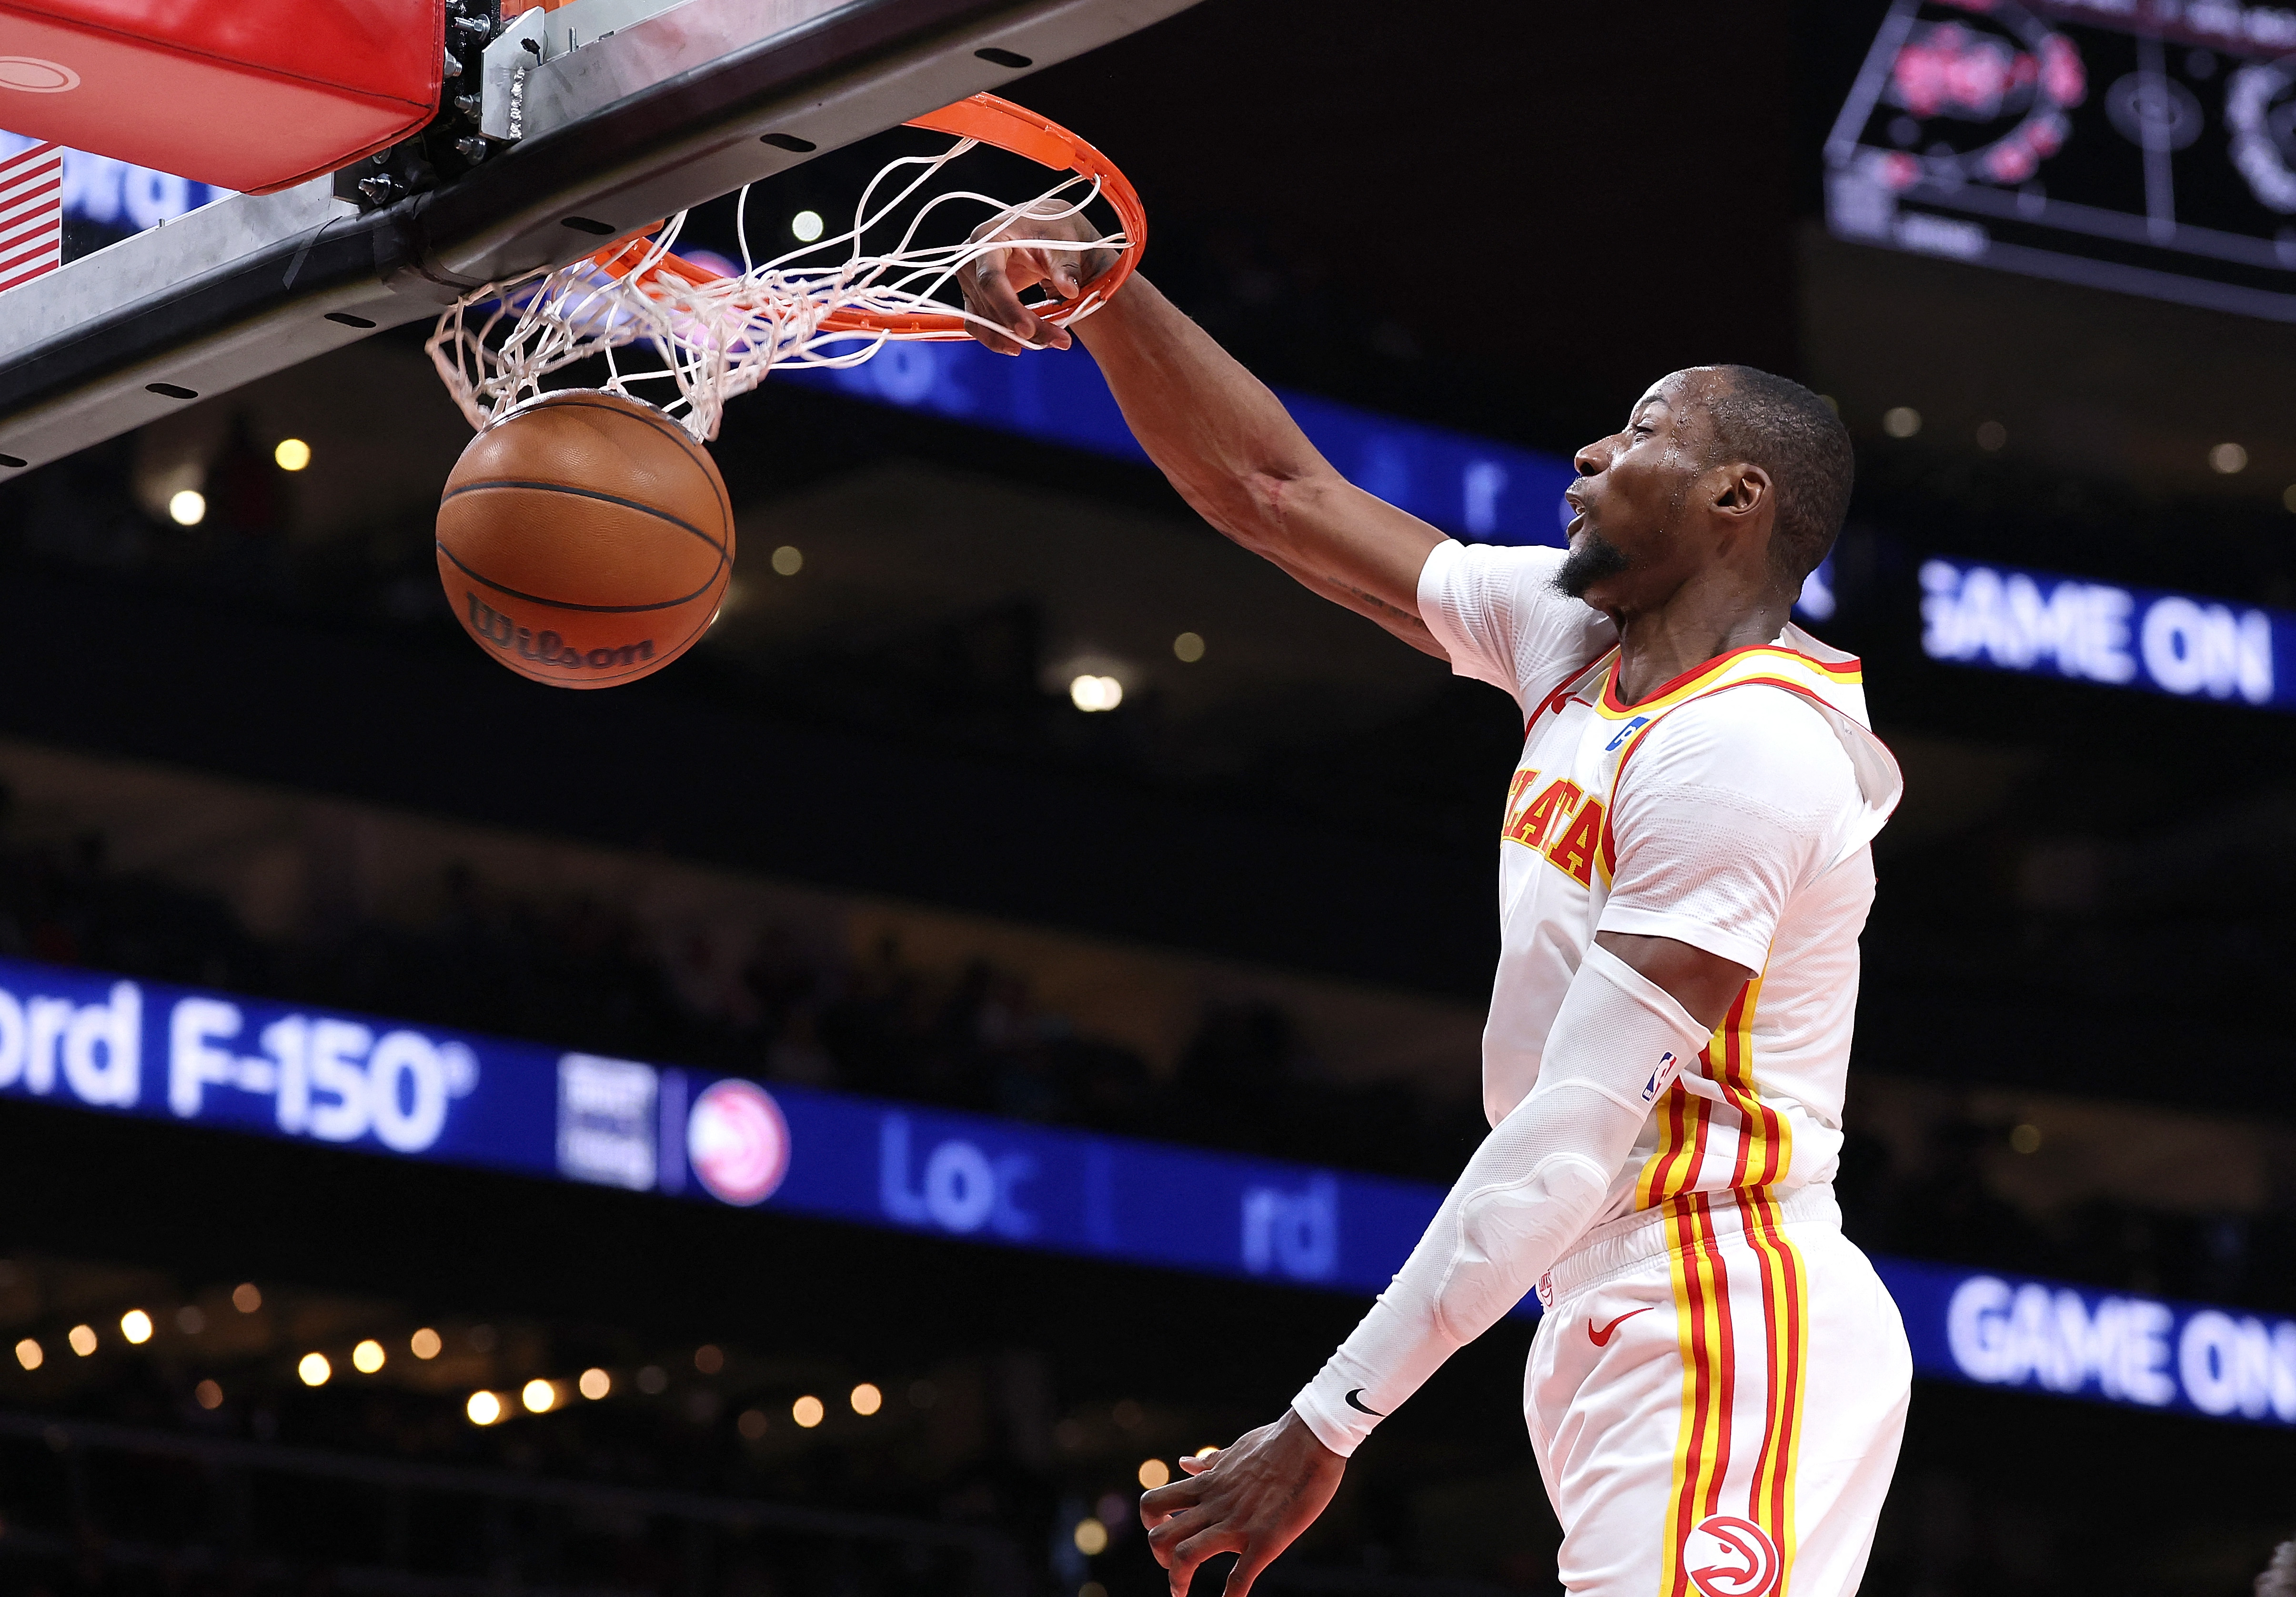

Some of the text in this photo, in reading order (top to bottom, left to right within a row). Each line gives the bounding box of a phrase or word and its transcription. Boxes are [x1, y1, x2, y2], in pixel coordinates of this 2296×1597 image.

[467, 592, 655, 669] Wilson
[2142, 596, 2274, 705] ON
[1946, 1276, 2296, 1424] GAME ON
